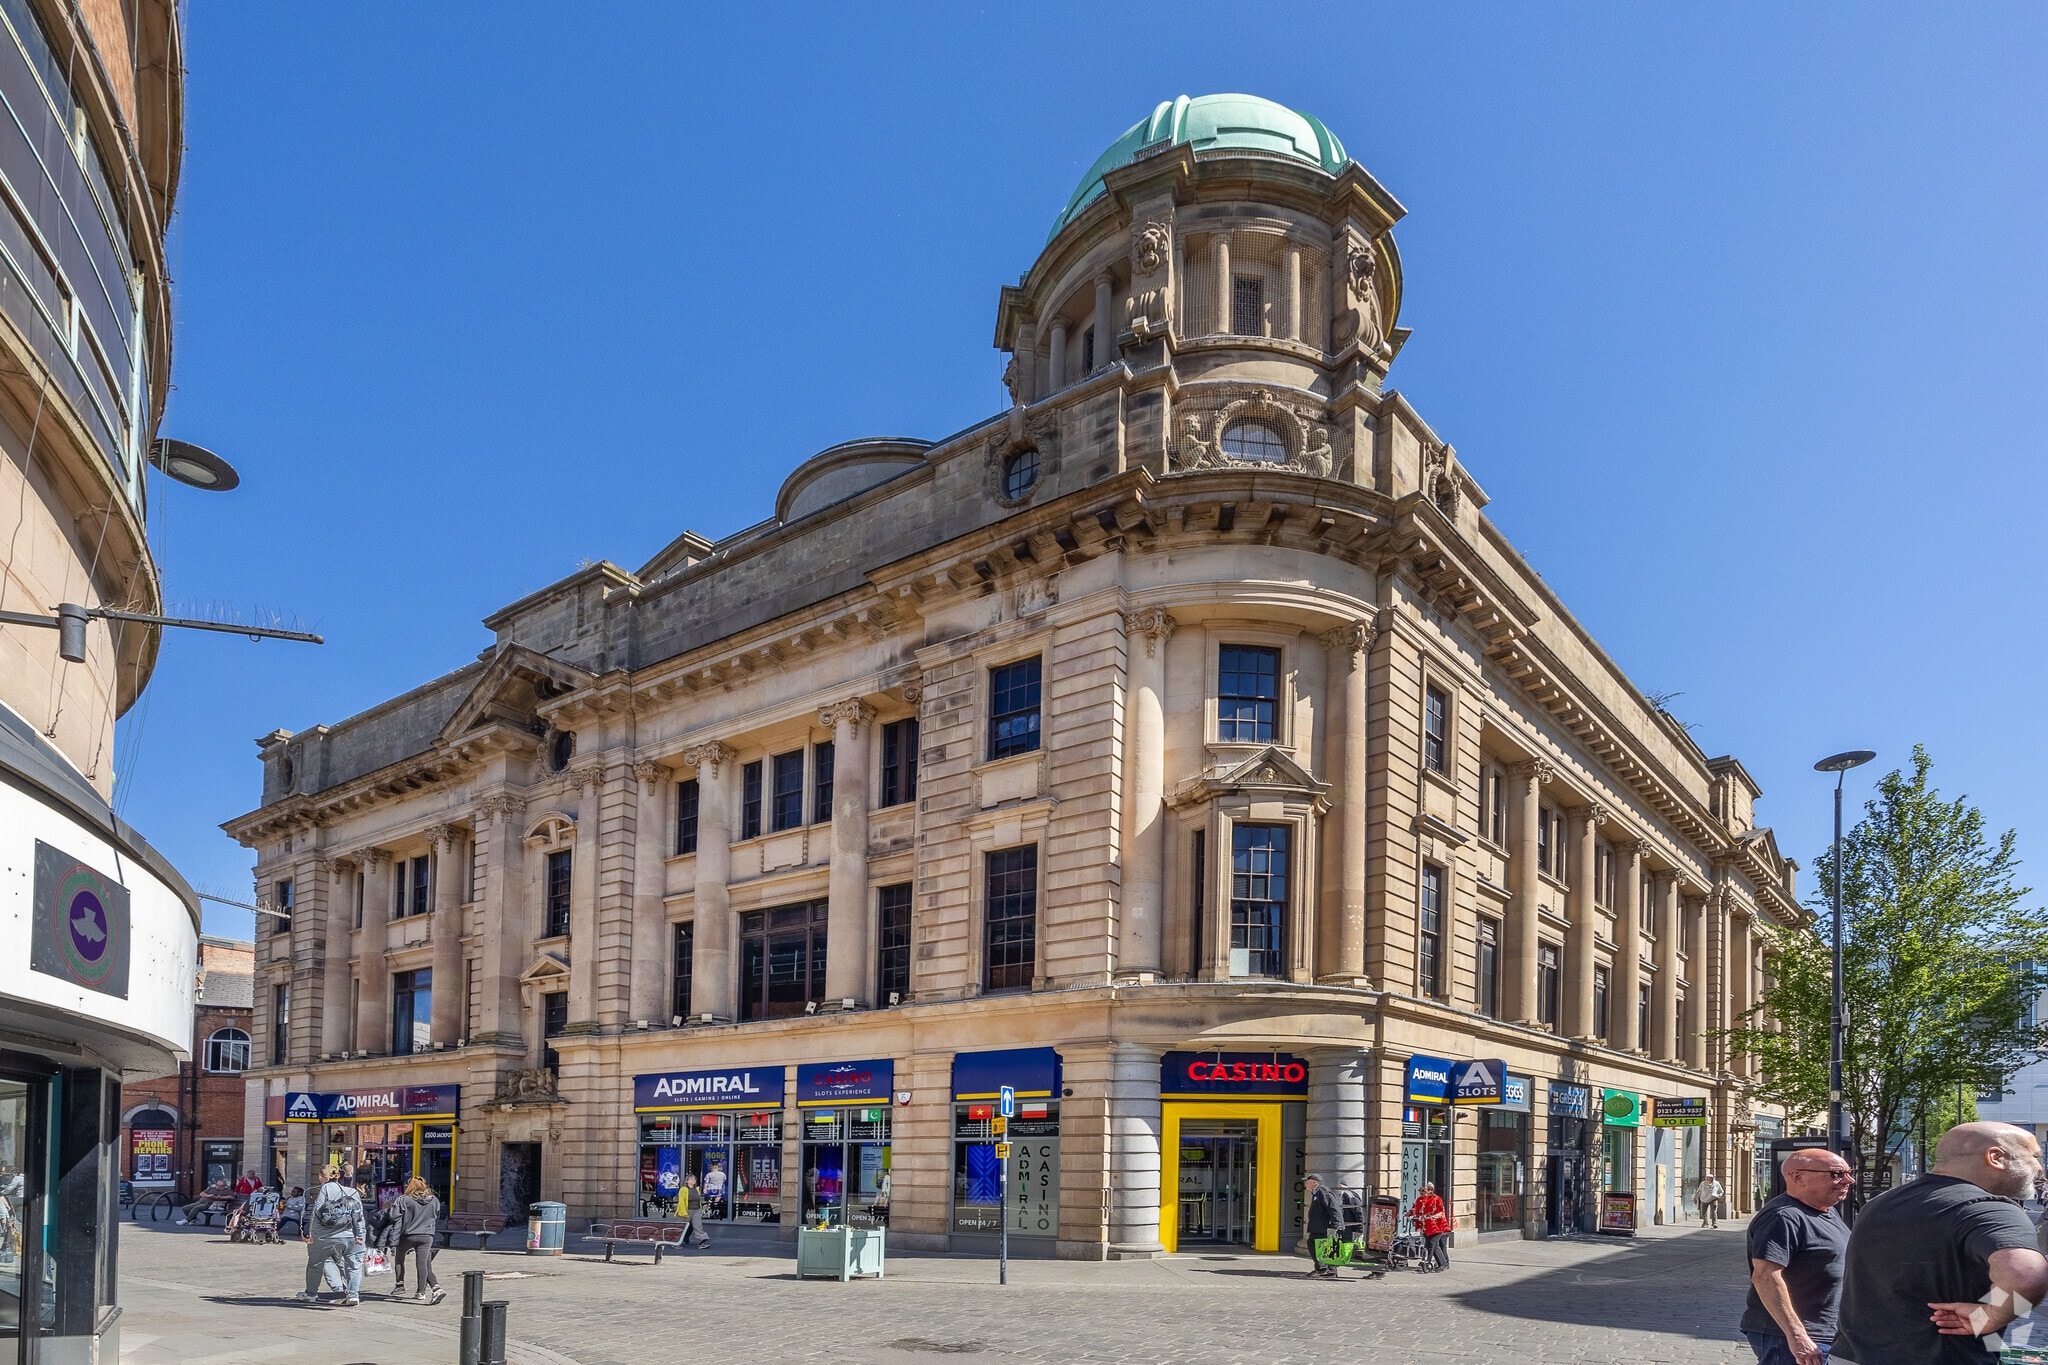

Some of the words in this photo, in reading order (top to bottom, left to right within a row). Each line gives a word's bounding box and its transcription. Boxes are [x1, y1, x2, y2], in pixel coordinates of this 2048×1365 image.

[814, 1071, 872, 1086] CASINO
[1188, 1061, 1305, 1083] CASINO
[1412, 1067, 1449, 1084] ADMIRAL
[653, 1072, 760, 1098] ADMIRAL
[834, 1088, 871, 1096] EXPERIENCE
[1457, 1087, 1497, 1097] SLOTS
[1505, 1084, 1524, 1100] EGGS
[336, 1091, 400, 1111] ADMIRAL
[752, 1159, 779, 1173] EEL
[1018, 1146, 1031, 1230] ADMIRAL
[1037, 1146, 1051, 1231] CASINO
